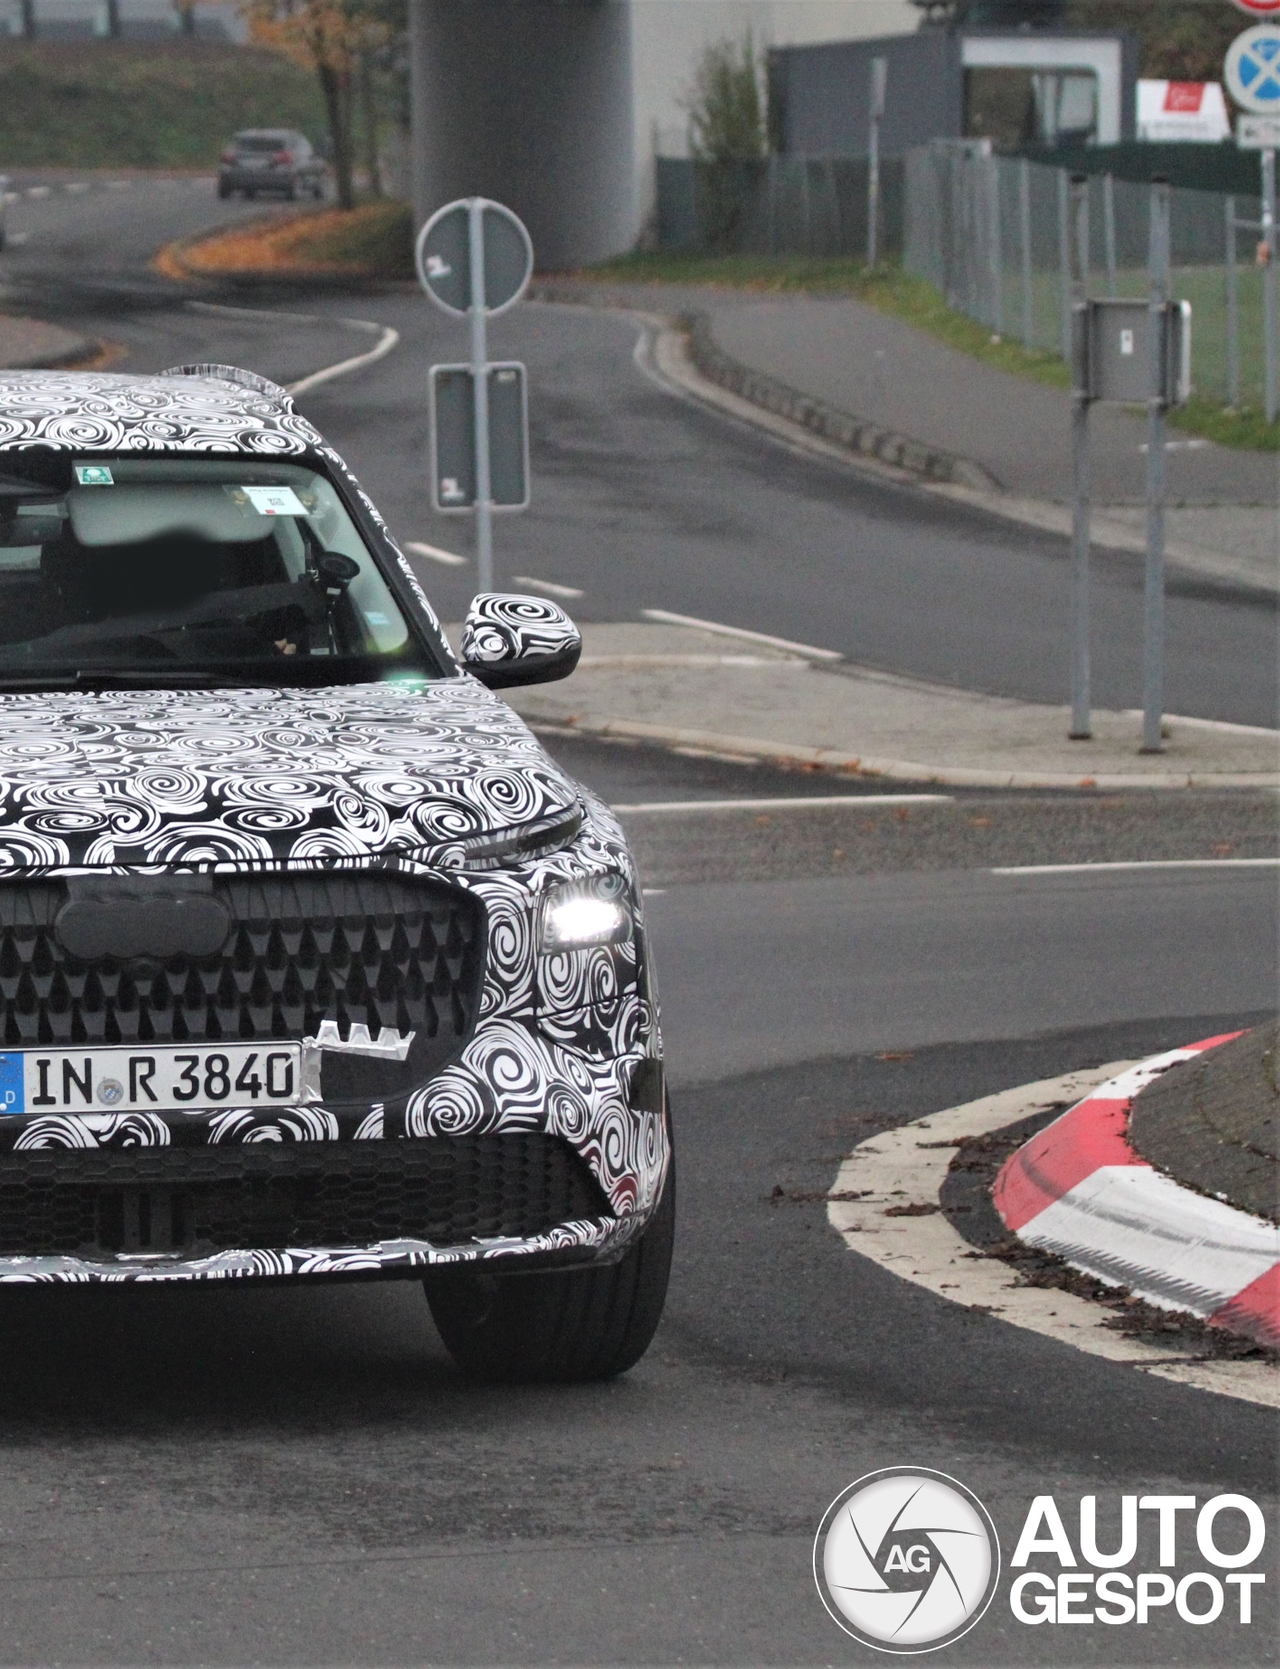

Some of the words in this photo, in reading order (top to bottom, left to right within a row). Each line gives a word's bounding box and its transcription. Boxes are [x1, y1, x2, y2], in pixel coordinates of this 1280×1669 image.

[33, 1058, 92, 1105] IN
[129, 1056, 158, 1102] R
[172, 1052, 294, 1100] 3840
[5, 1090, 16, 1104] D
